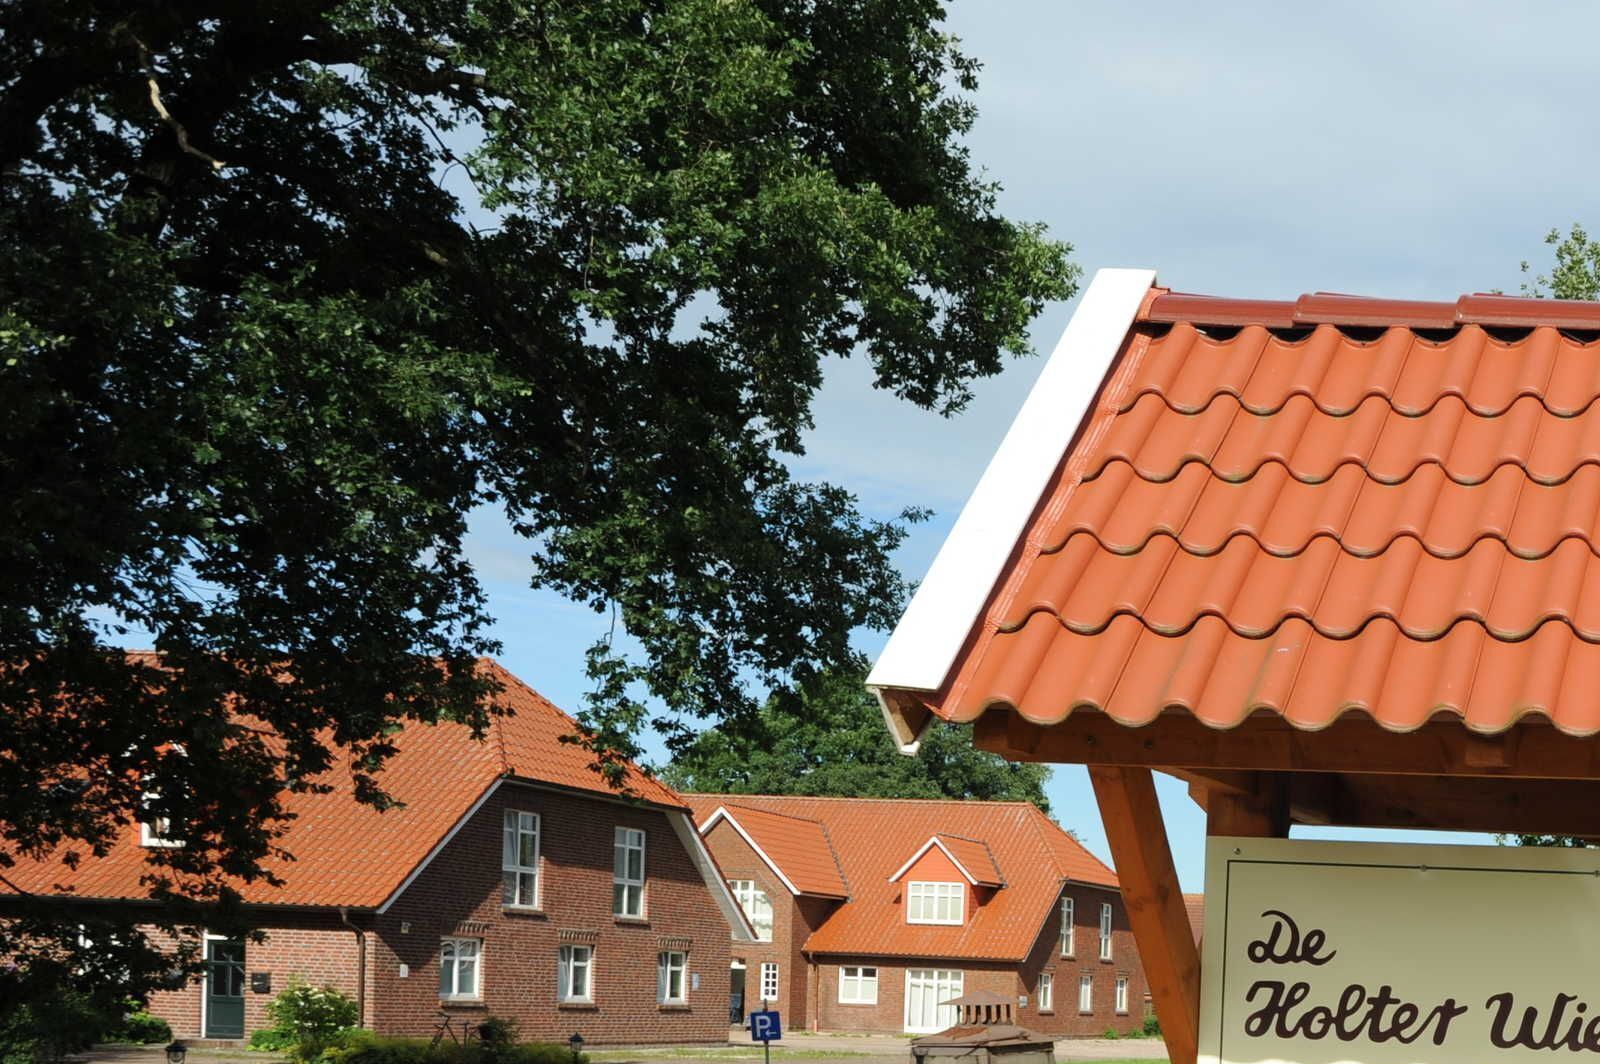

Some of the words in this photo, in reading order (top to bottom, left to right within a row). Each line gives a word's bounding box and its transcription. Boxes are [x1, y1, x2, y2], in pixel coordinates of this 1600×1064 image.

[1247, 909, 1337, 966] De
[755, 1015, 771, 1038] P
[1244, 980, 1468, 1046] Holter
